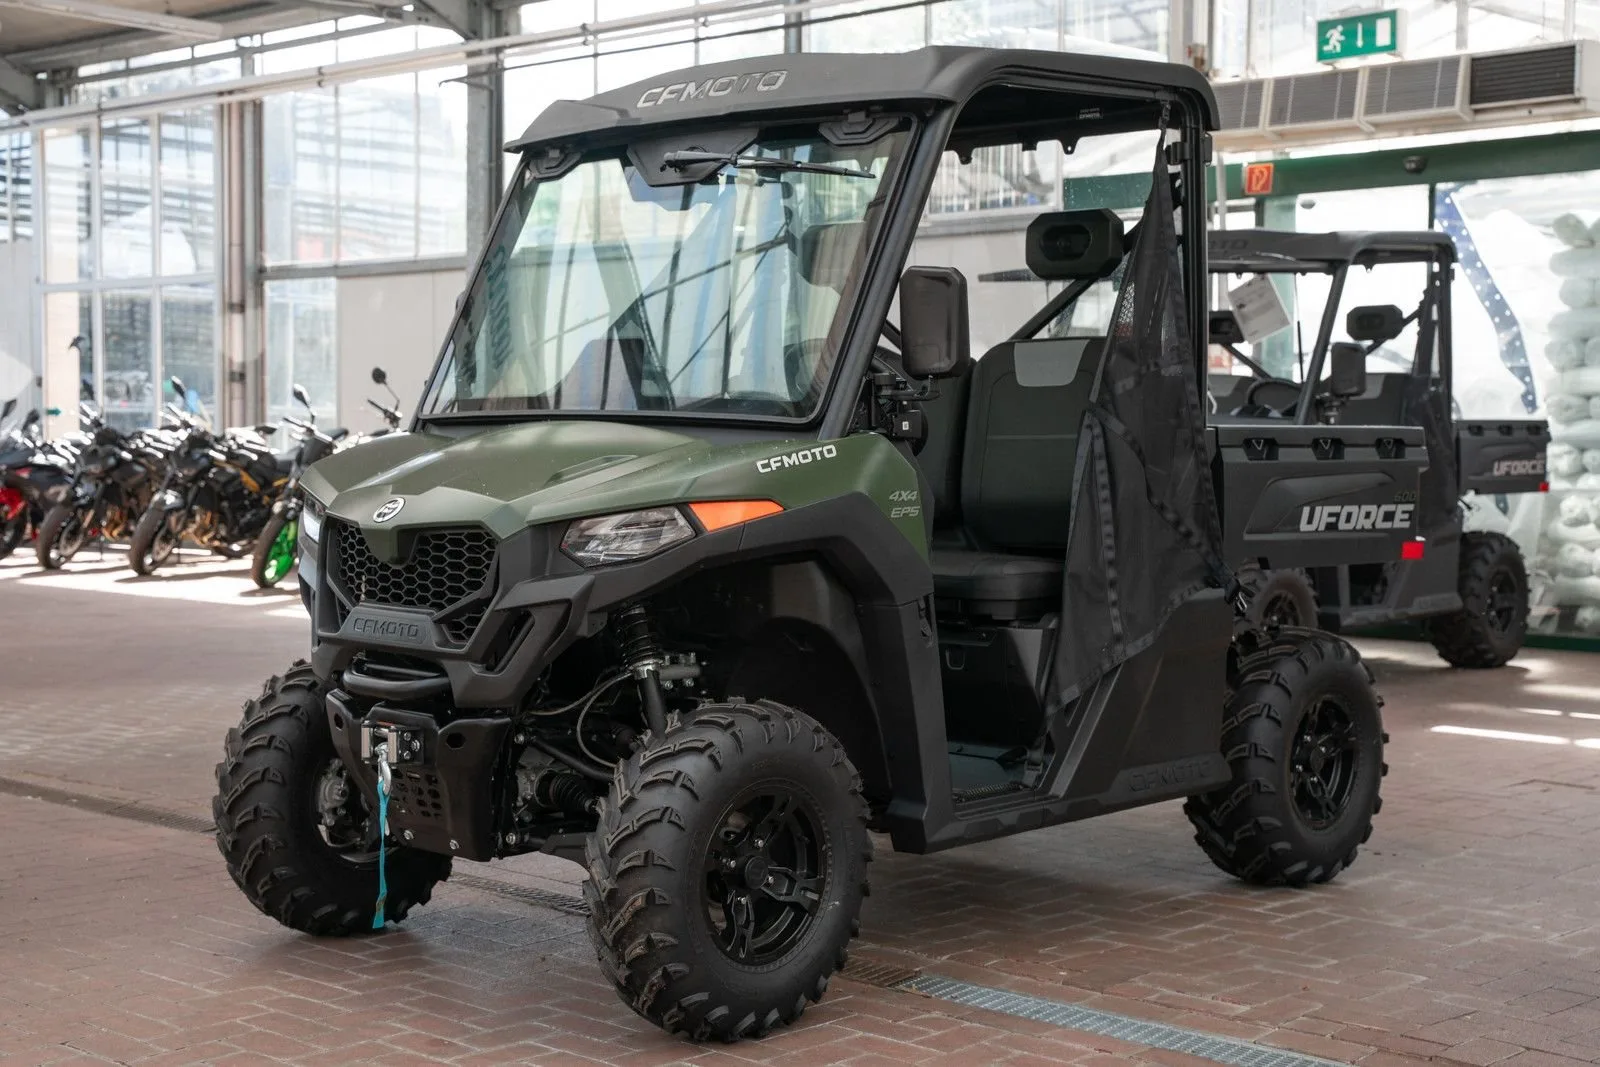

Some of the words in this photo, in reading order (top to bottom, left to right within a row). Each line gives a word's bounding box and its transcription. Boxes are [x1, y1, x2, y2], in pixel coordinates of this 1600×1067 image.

[636, 70, 788, 108] CFMOTO
[756, 444, 837, 473] CFMOTO
[1493, 460, 1545, 476] UFORCE
[890, 506, 921, 518] EPS
[1300, 503, 1415, 532] UFORCE
[353, 617, 419, 638] CFMOTO
